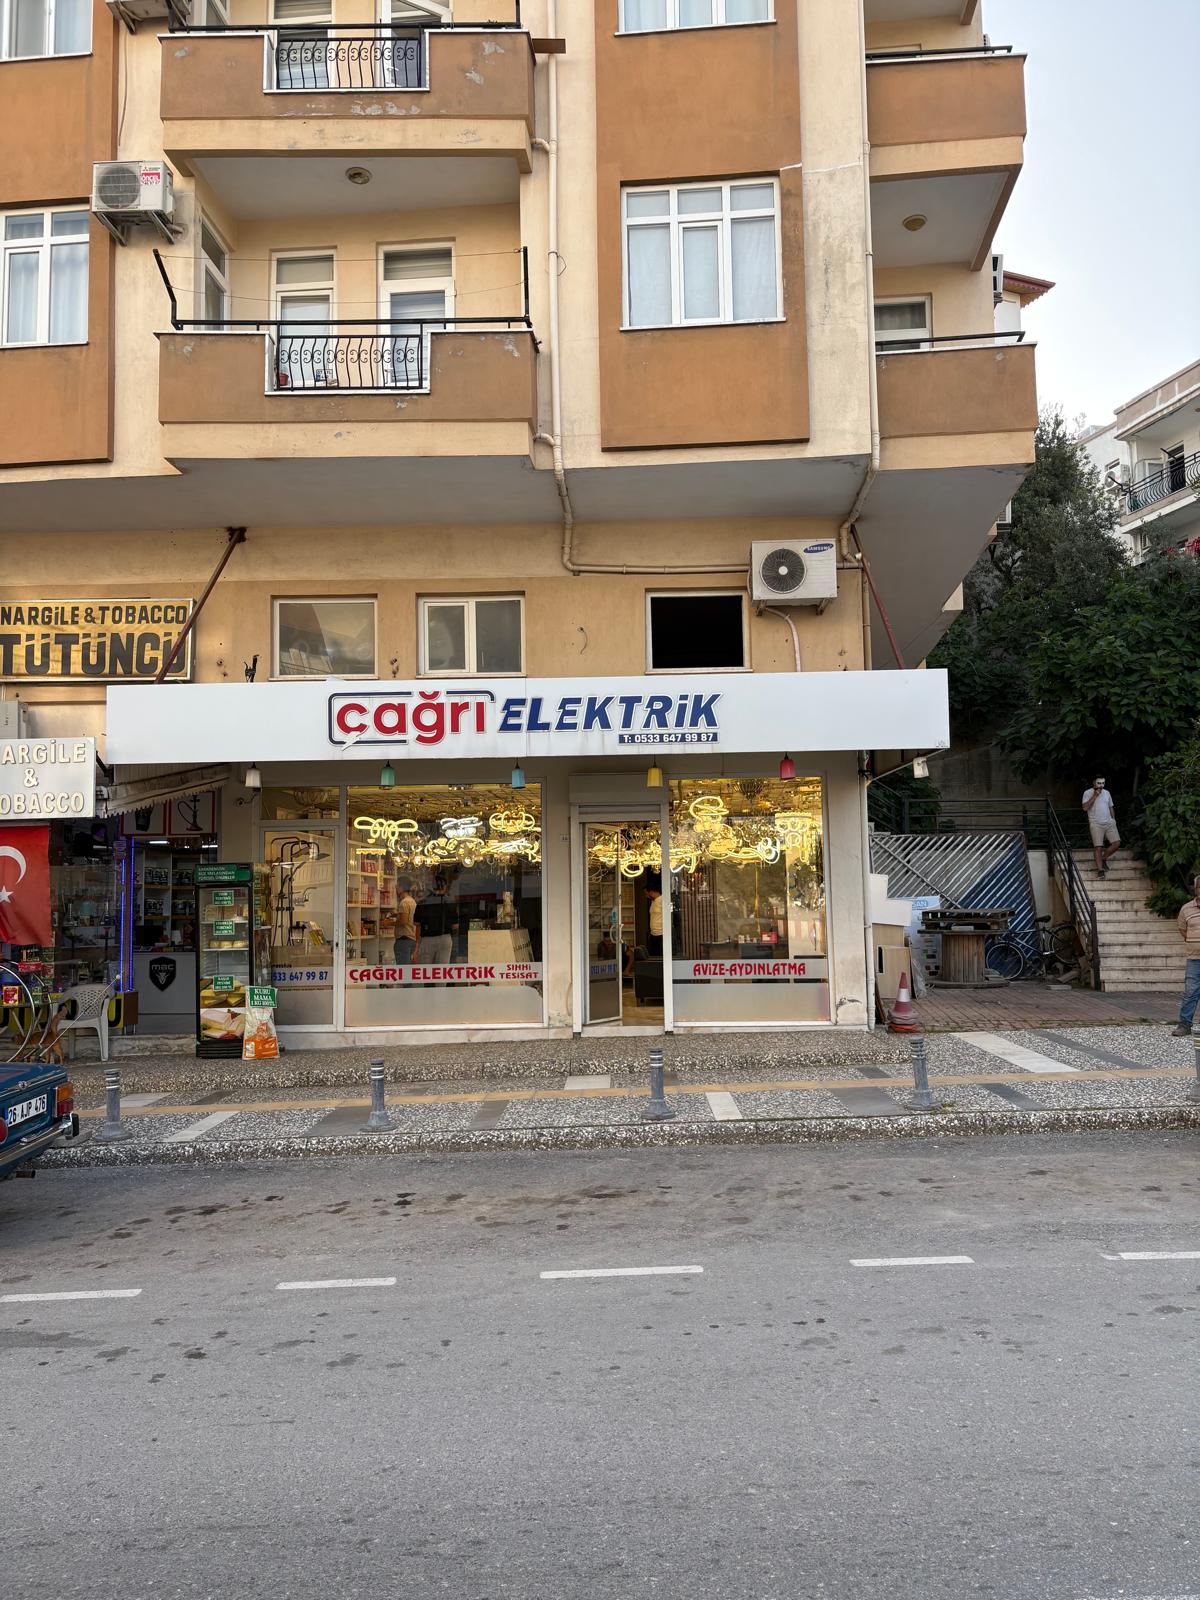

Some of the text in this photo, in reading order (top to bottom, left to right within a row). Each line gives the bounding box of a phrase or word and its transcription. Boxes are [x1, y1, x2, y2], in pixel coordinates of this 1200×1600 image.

[84, 606, 96, 624] &
[98, 605, 187, 624] TOBACCO
[0, 632, 185, 675] TÜTÜNCÜ
[624, 733, 713, 743] T: 0533 647 99 87
[24, 768, 39, 787] &
[0, 792, 84, 815] OBACCO
[289, 971, 303, 981] 647
[306, 971, 316, 980] 99
[319, 971, 328, 980] 87
[350, 965, 403, 984] ÇAĞRI
[8, 1108, 17, 1124] 26
